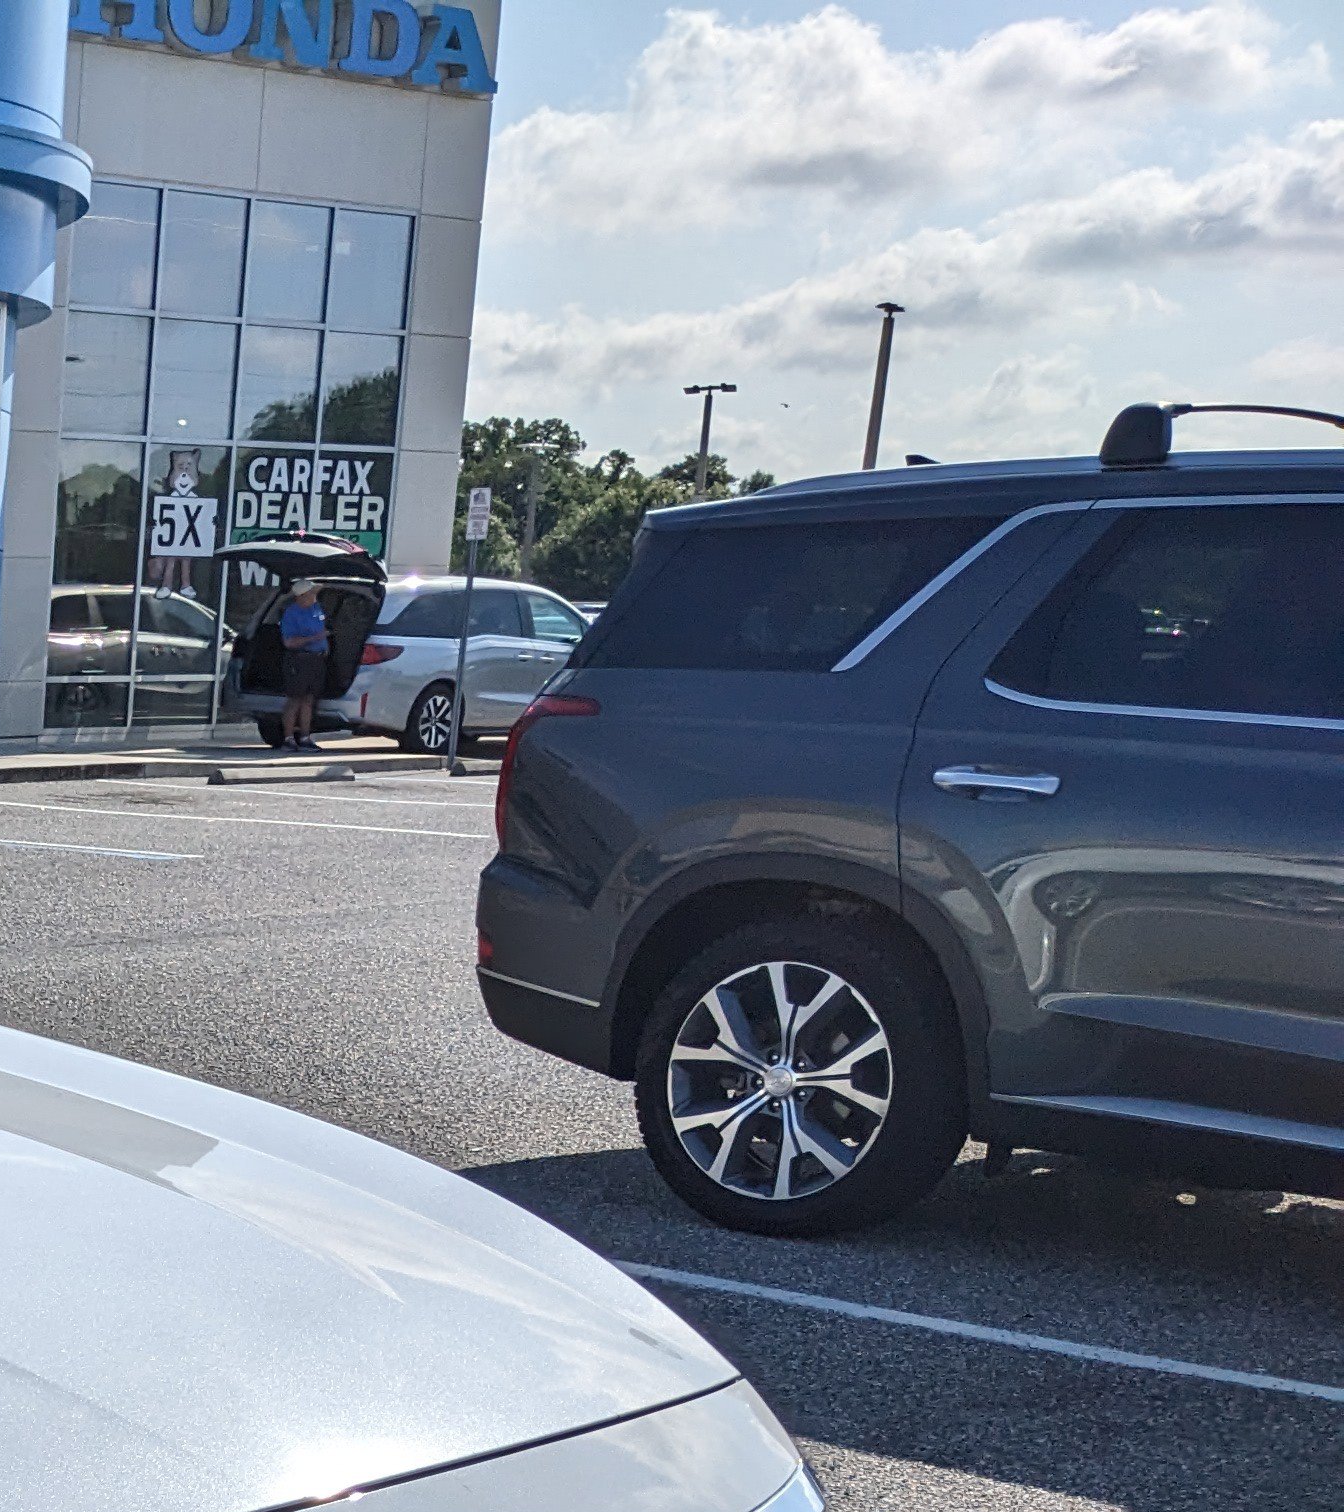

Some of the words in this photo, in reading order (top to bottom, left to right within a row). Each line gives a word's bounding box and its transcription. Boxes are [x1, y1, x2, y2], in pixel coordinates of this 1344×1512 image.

[248, 456, 375, 495] CARFAX
[157, 503, 203, 548] 5X
[234, 491, 385, 531] DEALER
